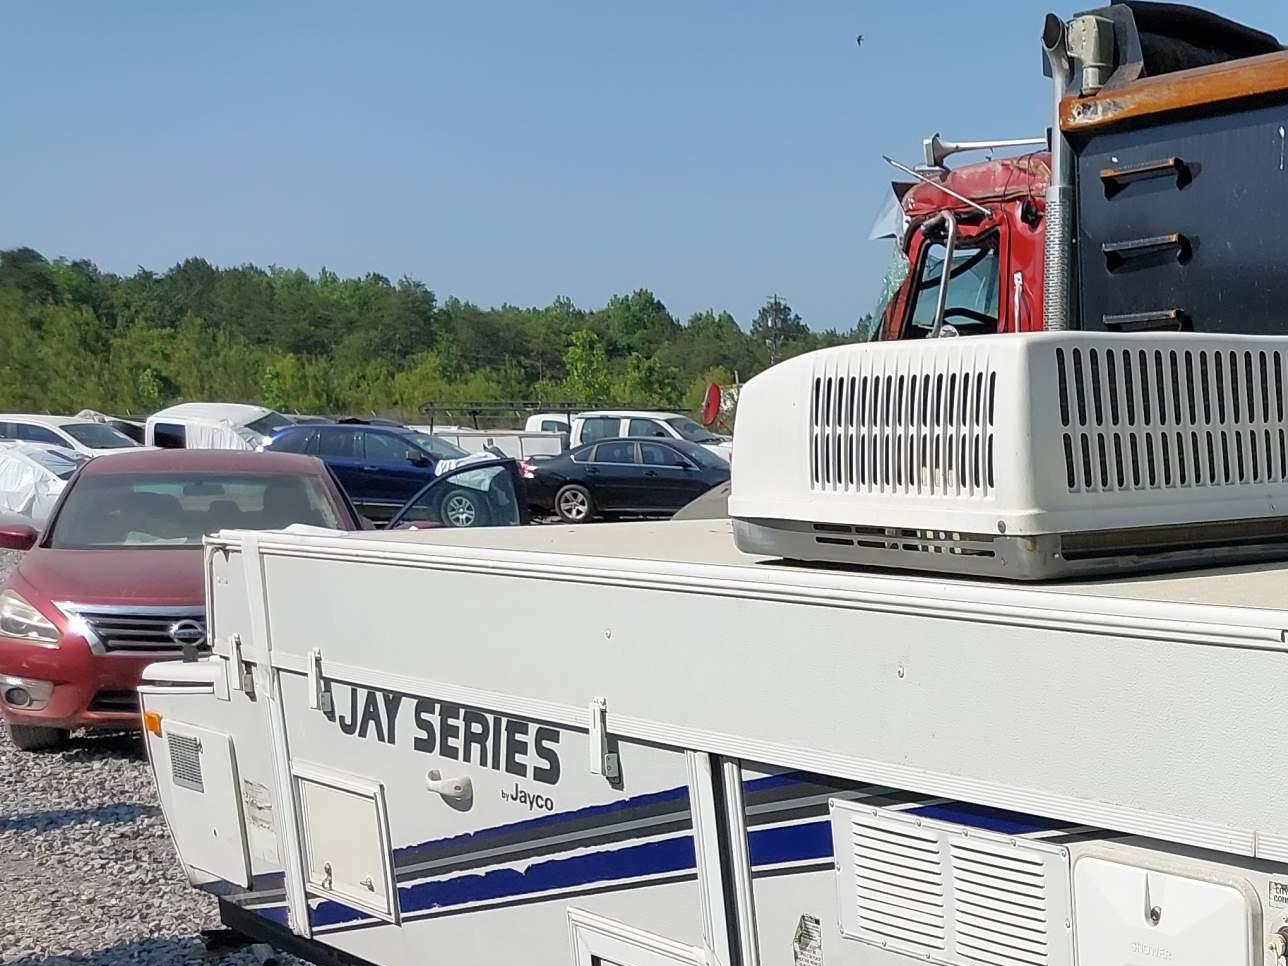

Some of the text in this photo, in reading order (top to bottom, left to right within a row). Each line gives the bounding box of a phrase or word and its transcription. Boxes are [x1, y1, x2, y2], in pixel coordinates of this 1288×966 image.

[339, 687, 560, 785] JAY SERIES
[502, 783, 554, 811] by Jayco
